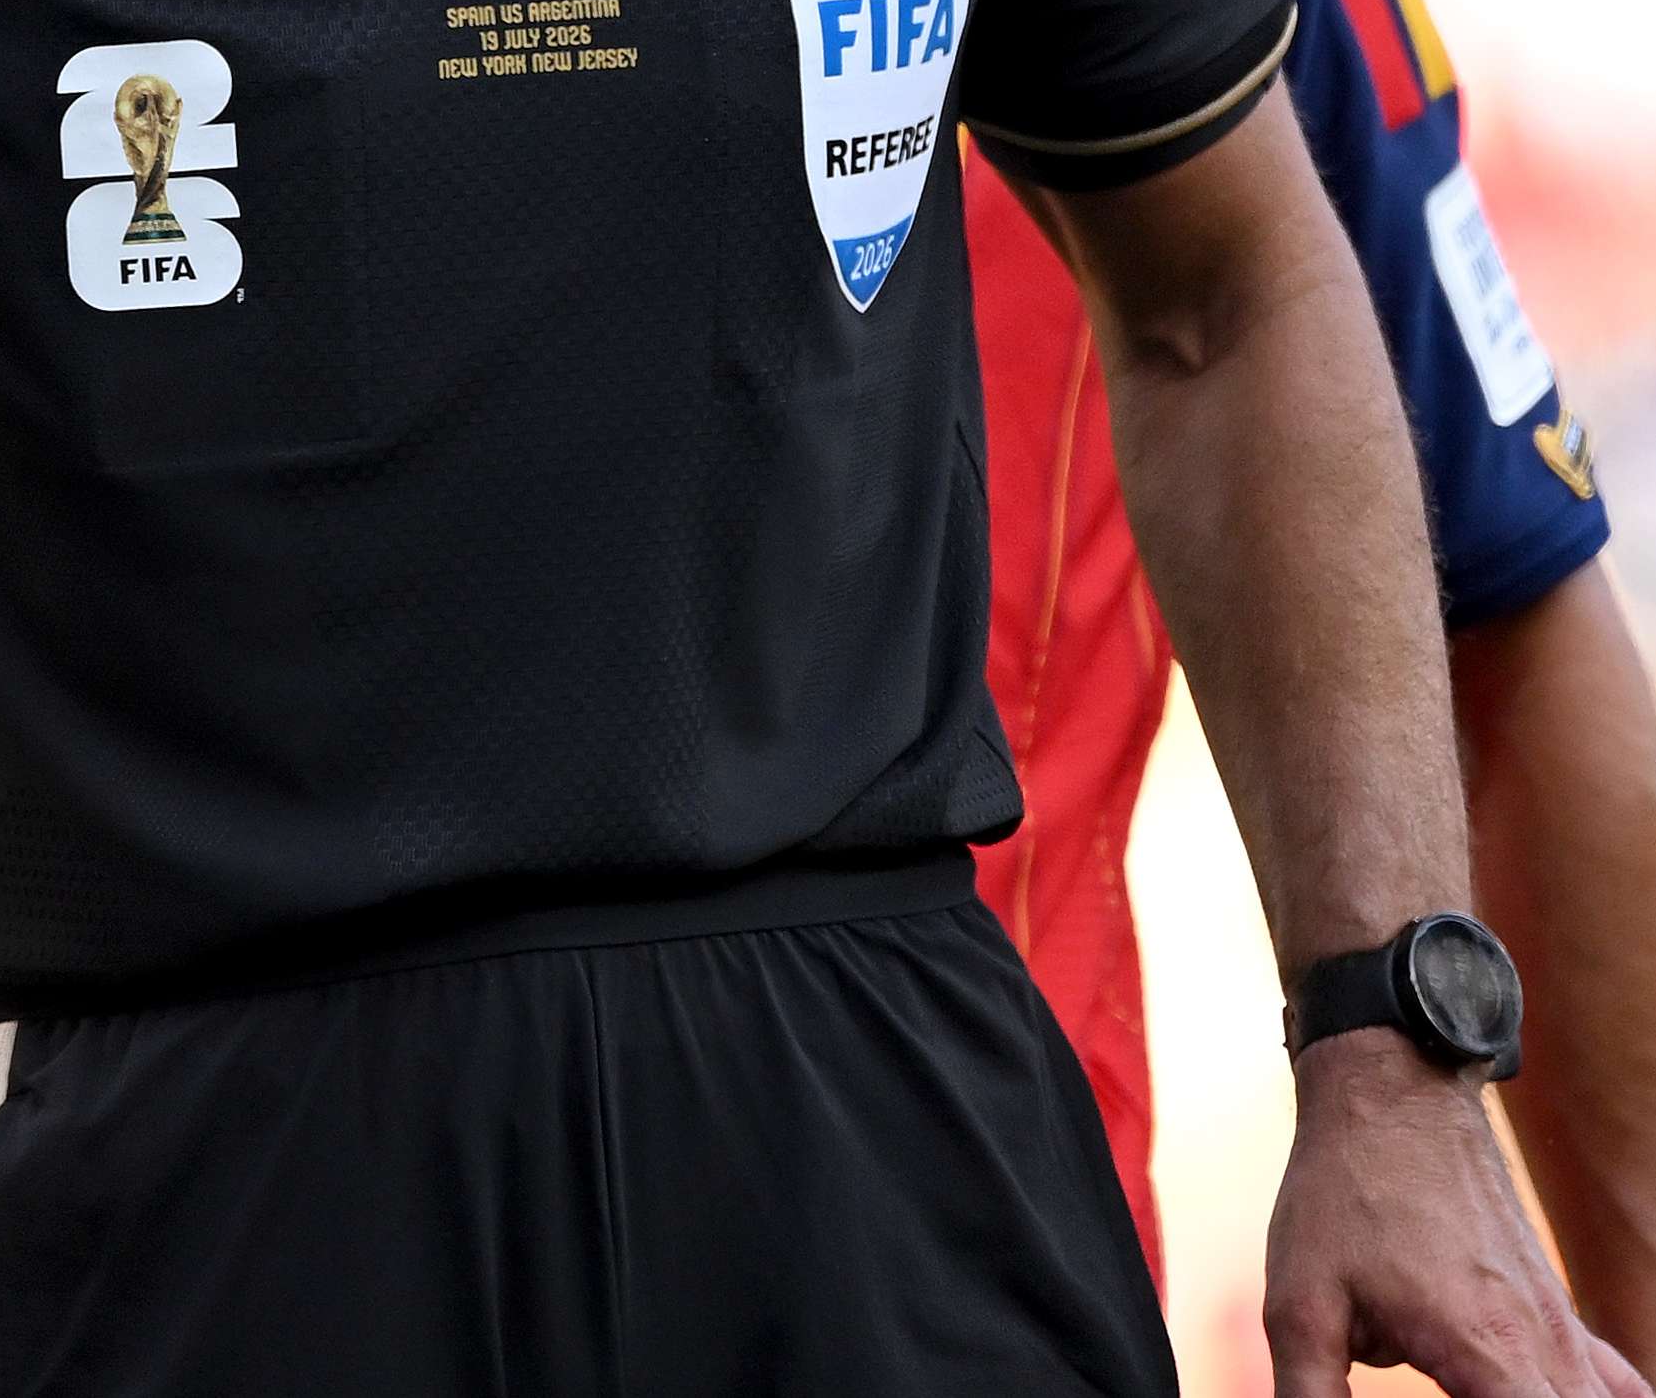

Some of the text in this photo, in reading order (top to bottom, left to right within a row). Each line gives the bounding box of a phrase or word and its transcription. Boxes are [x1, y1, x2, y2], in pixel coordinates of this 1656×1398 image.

[446, 5, 496, 28] SPAIN
[479, 24, 592, 51] 19 JULY 2026
[438, 47, 638, 79] NEW YORK NEW JERSEY
[826, 115, 935, 178] REFEREE
[119, 255, 197, 284] FIFA
[850, 235, 894, 280] 2026
